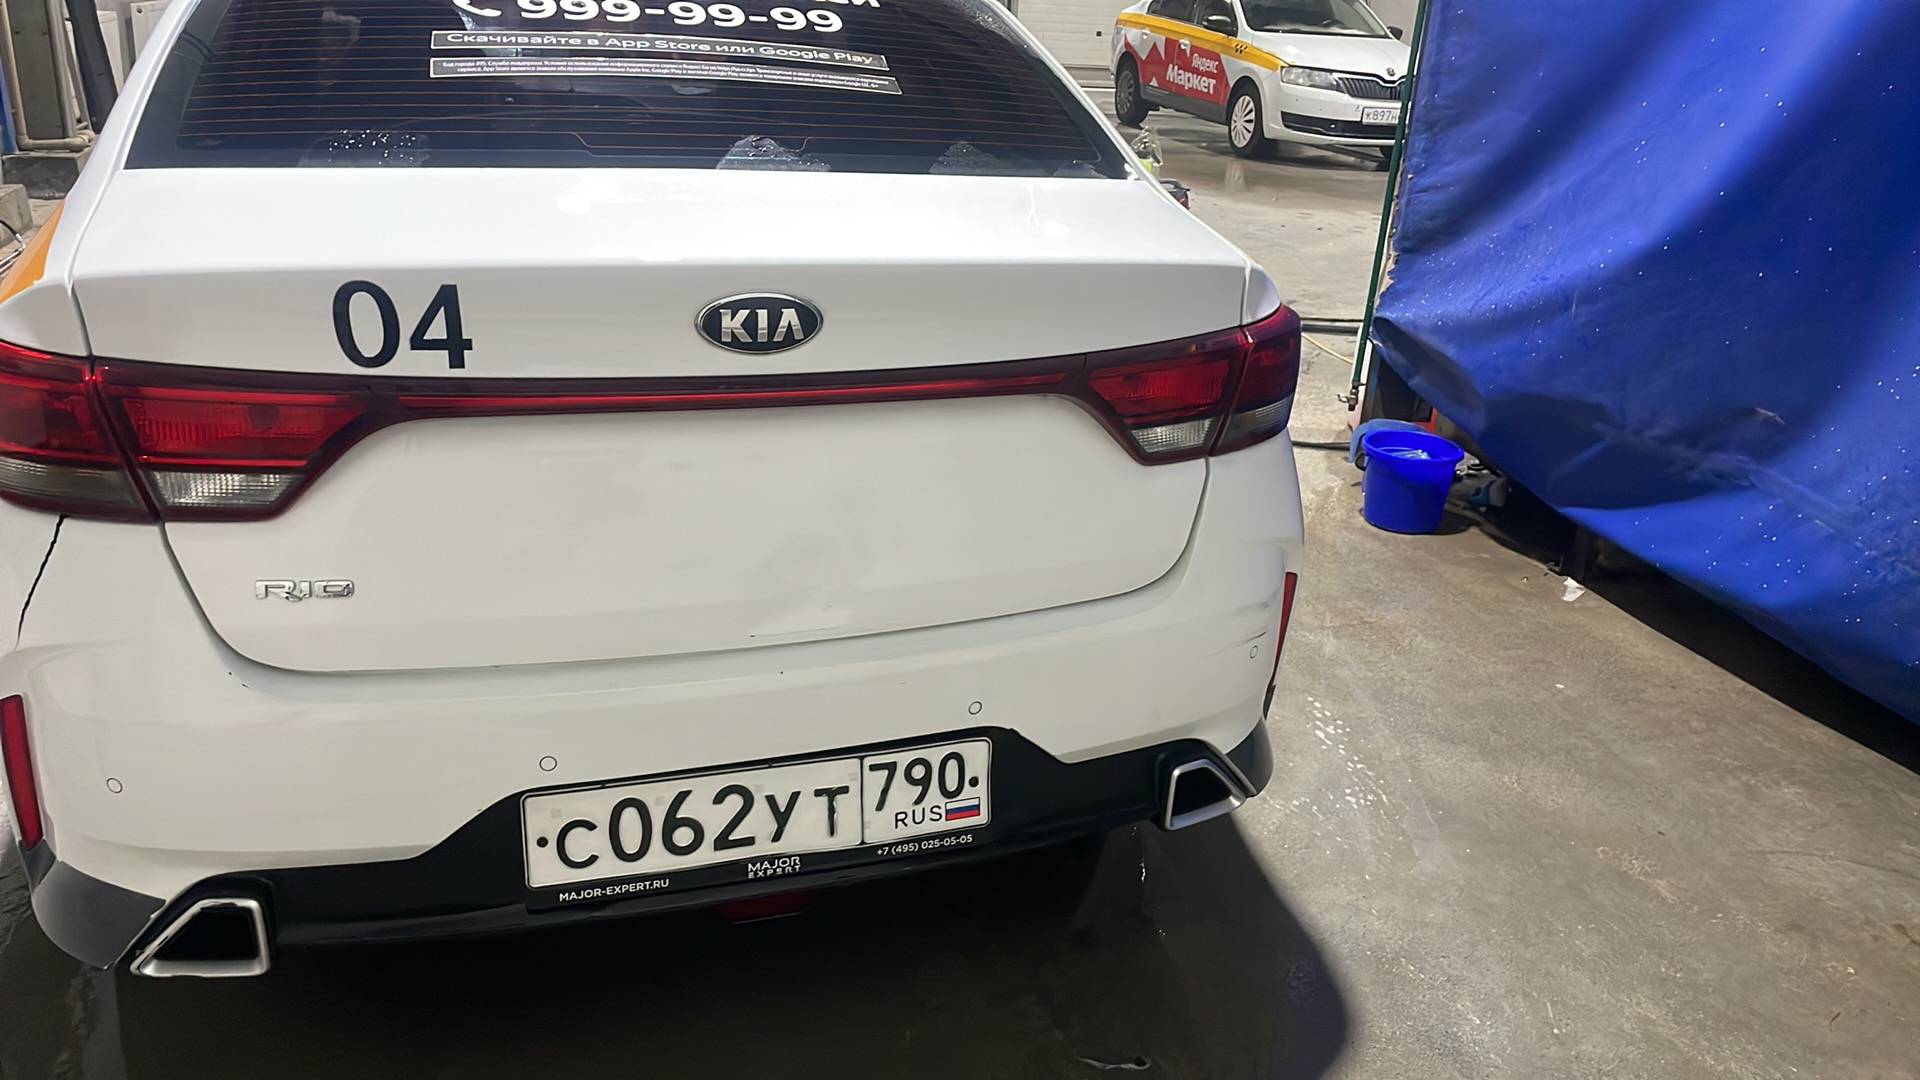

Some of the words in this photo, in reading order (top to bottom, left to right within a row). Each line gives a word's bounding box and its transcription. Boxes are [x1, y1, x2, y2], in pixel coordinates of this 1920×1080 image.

[520, 0, 843, 33] 999-99-99
[446, 33, 584, 46] Скачивайте
[586, 37, 599, 46] в
[604, 38, 650, 49] App
[655, 40, 711, 51] Store
[715, 44, 755, 54] или
[759, 46, 831, 60] Google
[833, 53, 874, 65] Play
[1191, 53, 1219, 73] Яндекс
[1166, 63, 1217, 95] Маркет
[333, 280, 472, 370] 04
[719, 308, 805, 343] KIA
[255, 579, 355, 601] RIO
[556, 784, 850, 869] С062УТ
[869, 752, 966, 812] 790
[894, 804, 943, 829] RUS
[877, 845, 889, 856] +7
[891, 842, 919, 856] (495)
[921, 834, 974, 851] 025-05-05
[747, 856, 801, 872] MAJOR
[747, 865, 801, 879] EXPERT
[559, 878, 670, 902] MAJOR-EXPERT.RU
